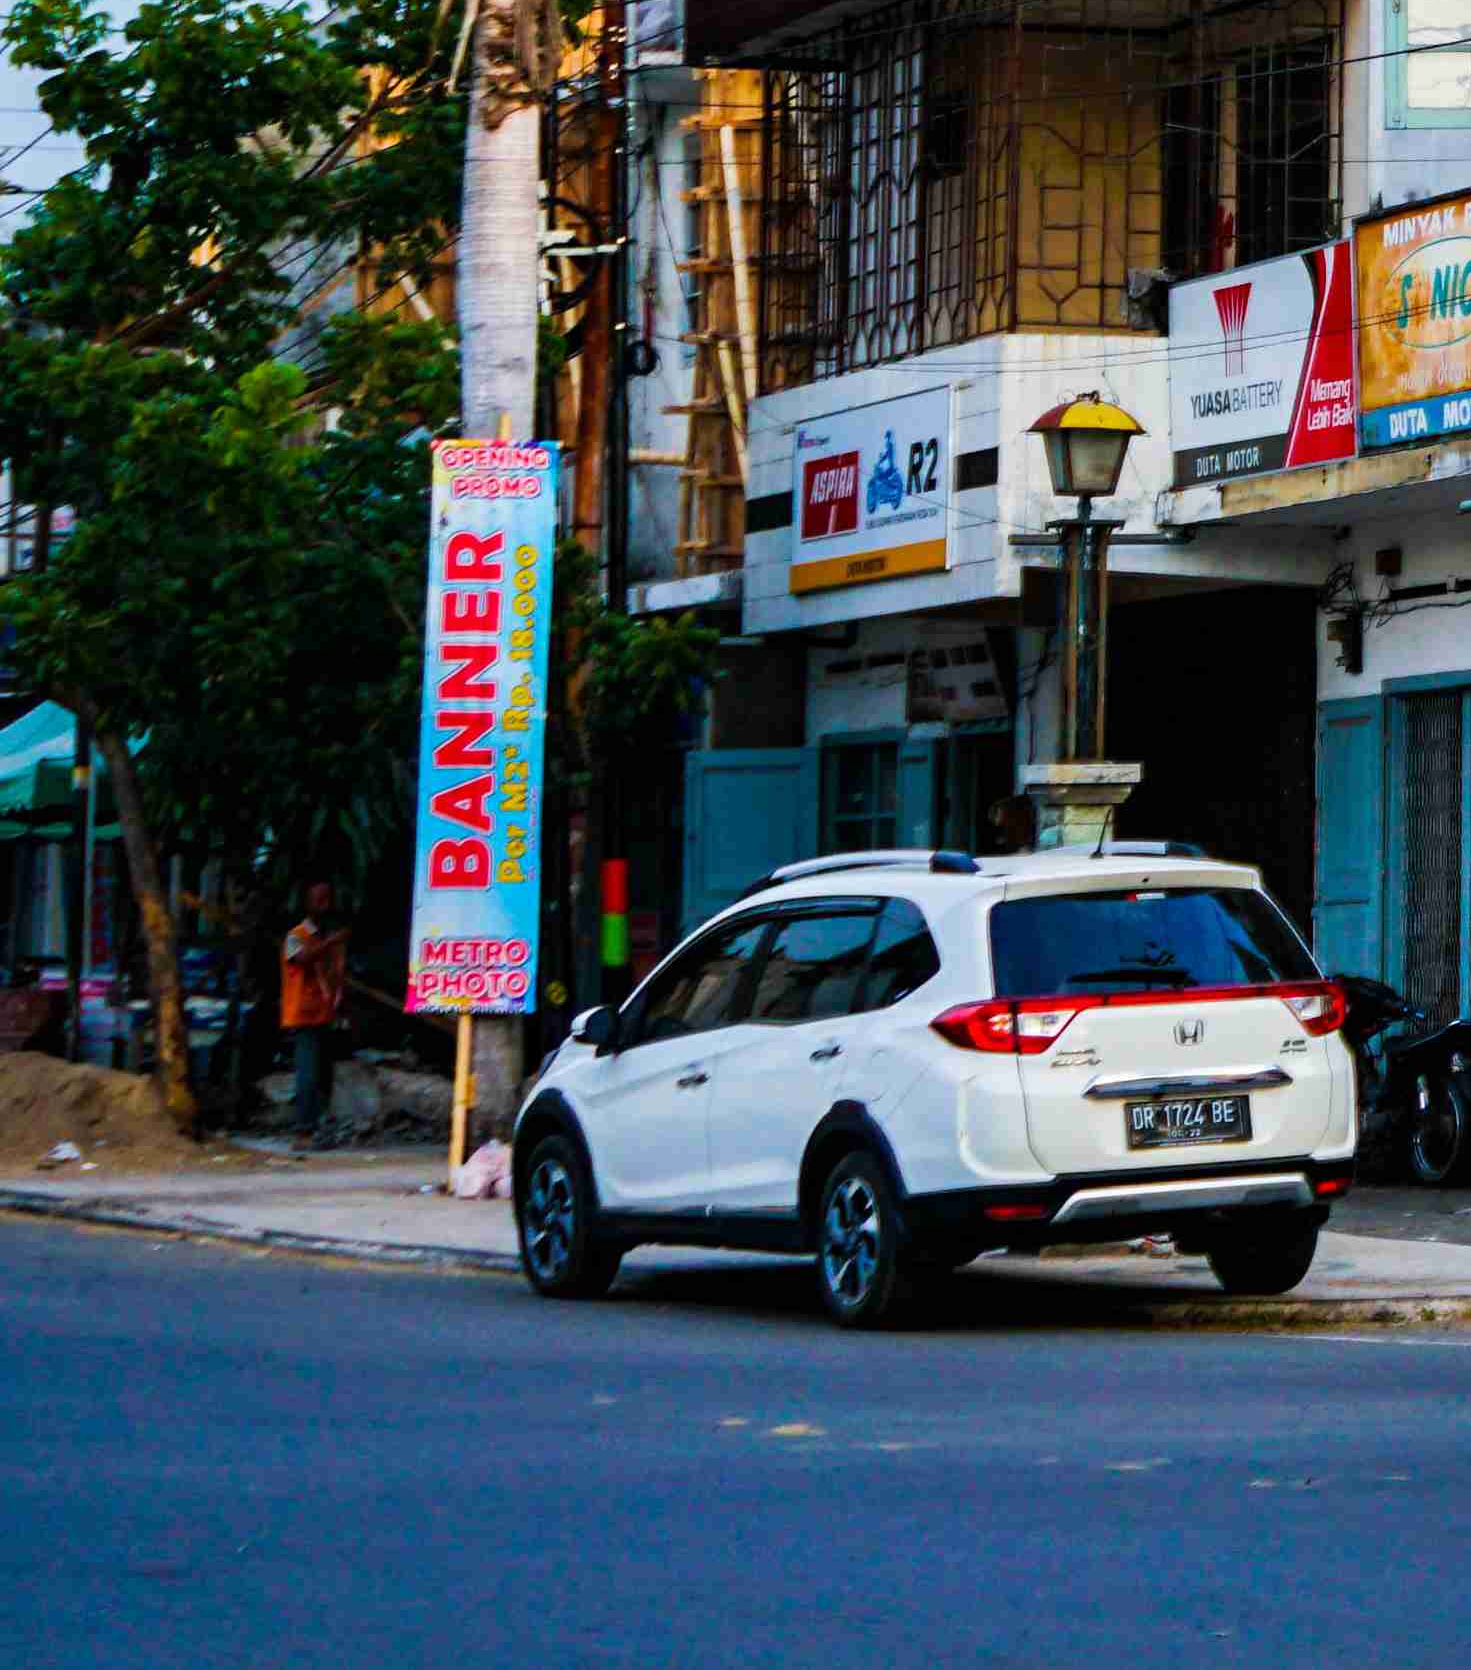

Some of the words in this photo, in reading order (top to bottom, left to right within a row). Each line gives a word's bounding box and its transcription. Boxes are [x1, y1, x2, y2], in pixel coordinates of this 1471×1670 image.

[1383, 206, 1456, 249] MINYAK
[1190, 390, 1231, 419] YUASA
[1233, 380, 1283, 412] BATTERY
[1310, 378, 1351, 402] Memang
[1308, 407, 1330, 430] Lebih
[1389, 407, 1427, 439] DUTA
[442, 448, 549, 470] OPENING
[906, 438, 938, 496] R2
[1196, 454, 1220, 477] DUTA
[1227, 447, 1259, 471] MOTOR
[452, 475, 541, 499] PROMO
[810, 465, 854, 505] ASPIRA
[508, 543, 538, 662] 18.000
[428, 529, 506, 891] BANNER
[422, 938, 529, 966] METRO
[415, 970, 529, 999] PHOTO
[1132, 1107, 1155, 1130] DR
[1161, 1103, 1204, 1128] 1724
[1212, 1100, 1234, 1123] BE
